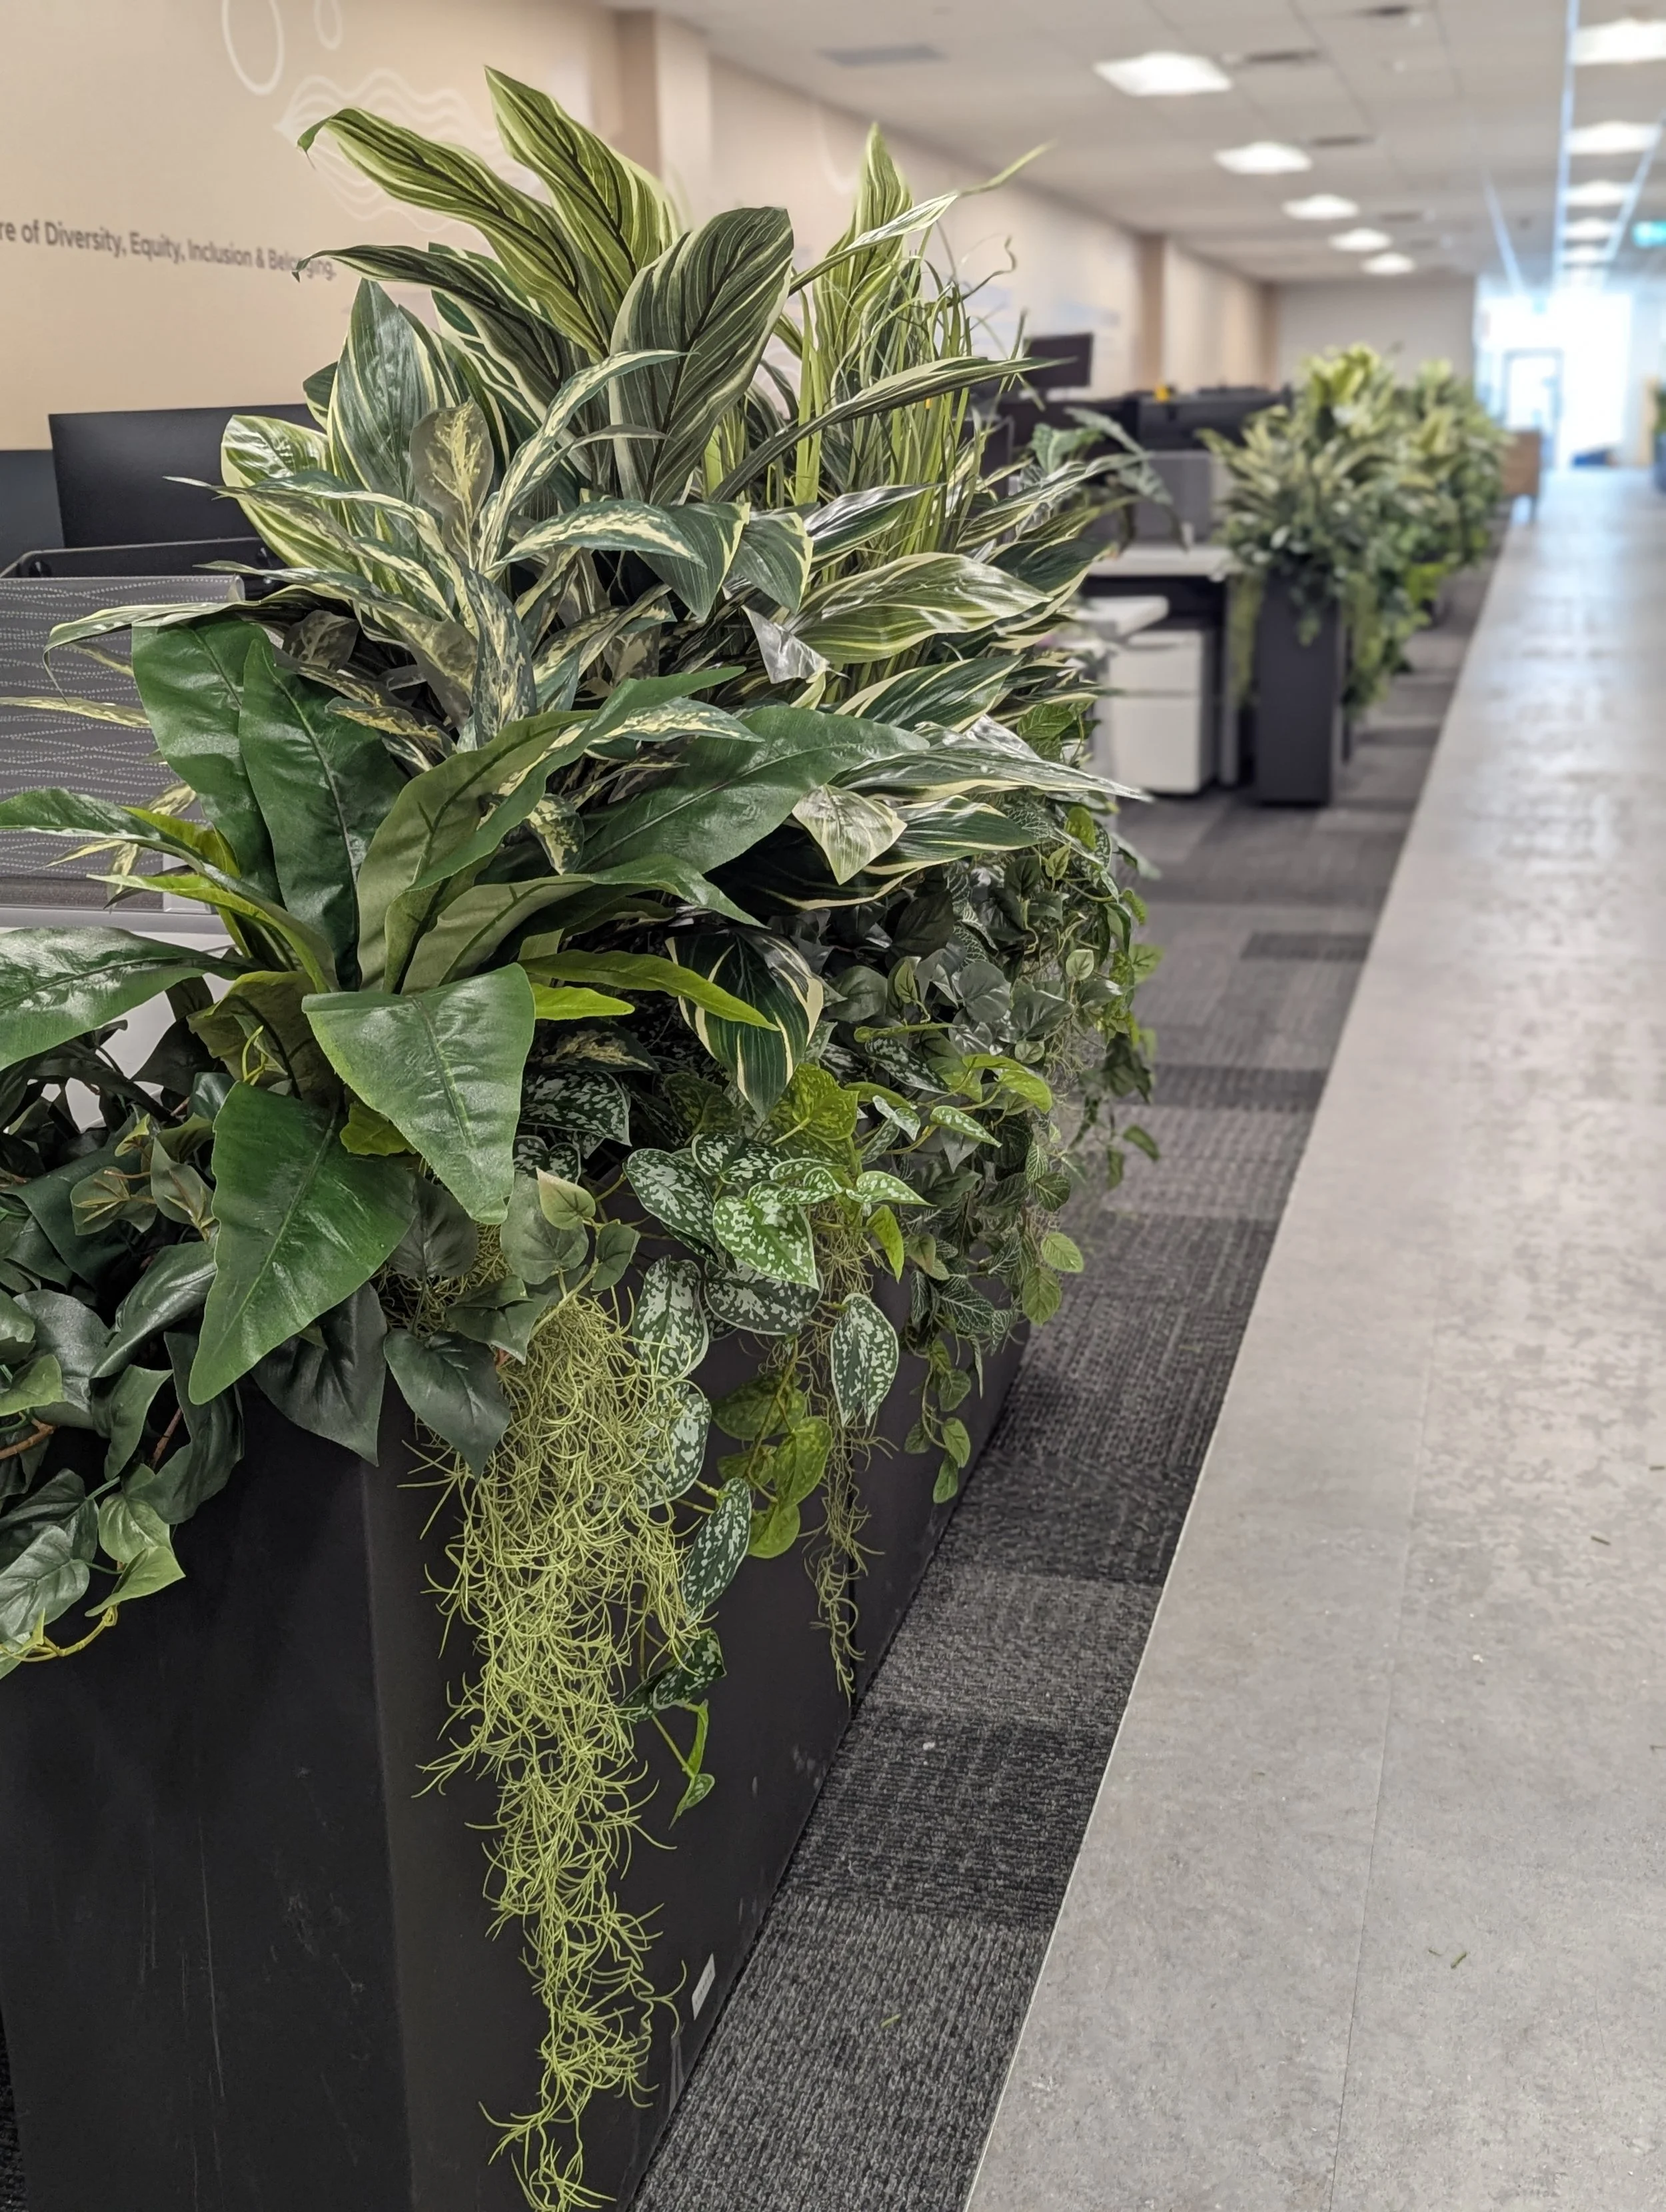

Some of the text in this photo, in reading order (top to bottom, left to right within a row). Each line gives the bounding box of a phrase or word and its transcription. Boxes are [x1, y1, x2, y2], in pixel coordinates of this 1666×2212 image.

[21, 219, 39, 244] of
[45, 221, 127, 258] Diversity,
[129, 231, 184, 265] Equity,
[187, 239, 253, 267] Inclusion
[256, 247, 265, 269] &
[268, 249, 337, 281] Beloging.
